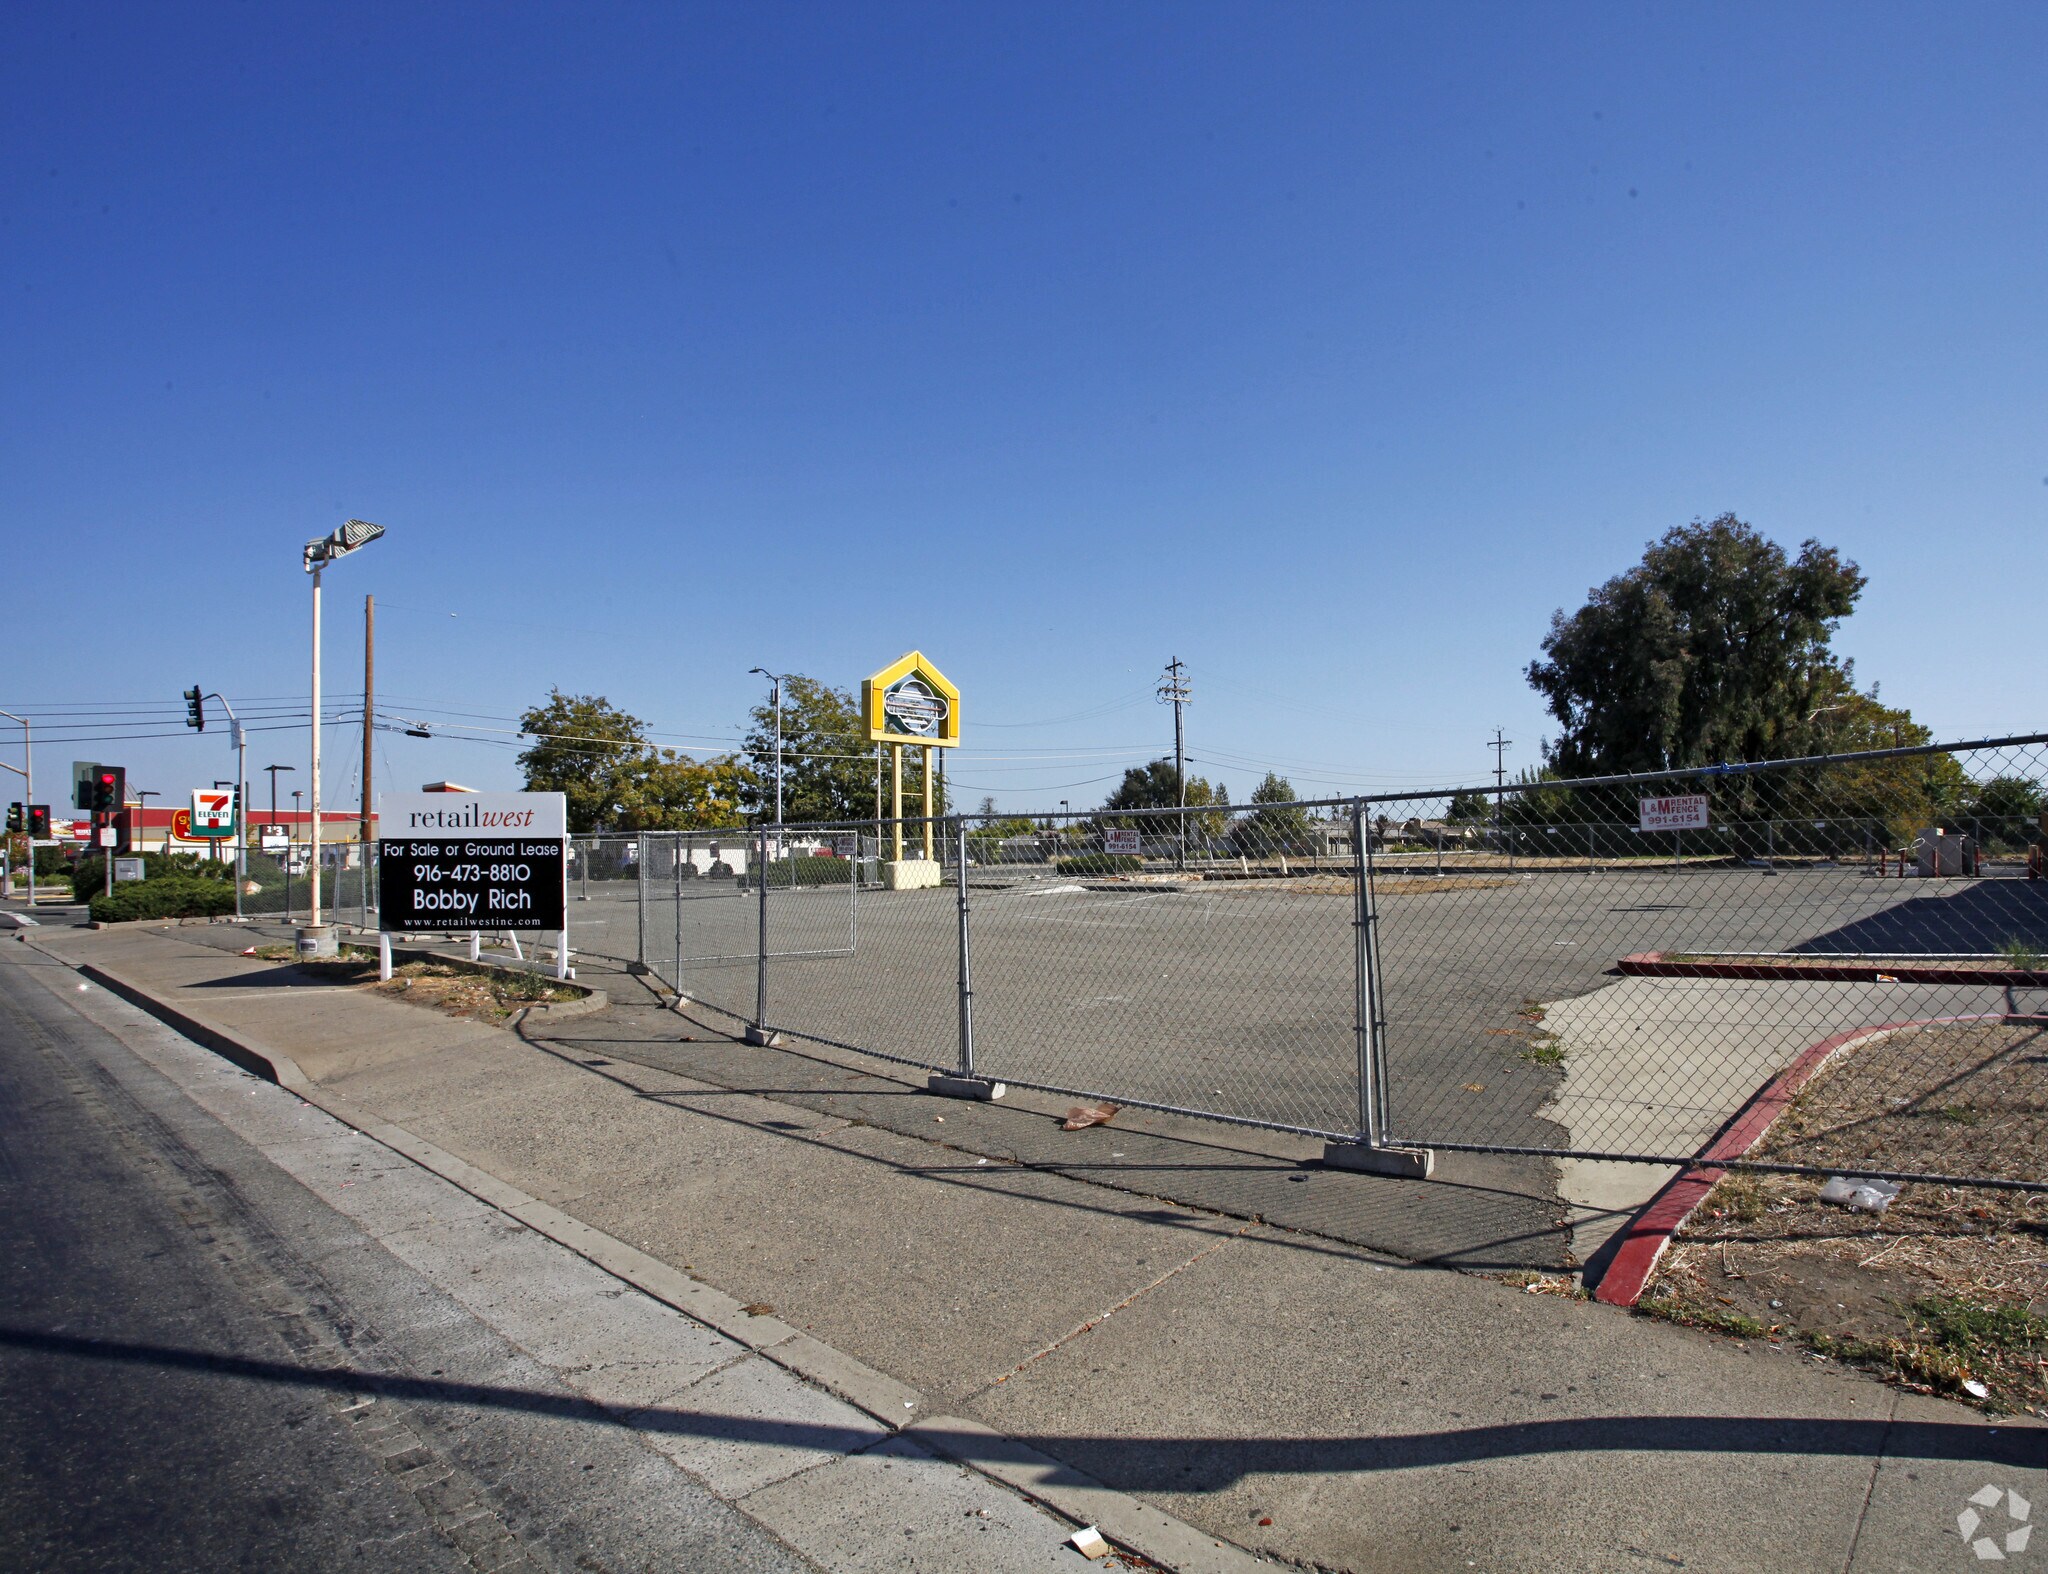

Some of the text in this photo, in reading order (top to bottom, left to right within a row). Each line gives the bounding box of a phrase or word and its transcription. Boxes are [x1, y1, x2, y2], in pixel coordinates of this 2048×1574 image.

[200, 795, 228, 829] 7
[409, 803, 534, 828] retailwest
[1641, 797, 1704, 816] L&M RENTAL
[1671, 805, 1699, 814] FENCE
[1648, 814, 1700, 825] 991-6154
[384, 842, 559, 857] For Sale or Ground Lease
[414, 864, 531, 882] 916-473-8810
[414, 889, 531, 914] Bobby Rich
[404, 917, 541, 926] www.retailwestinc.com
